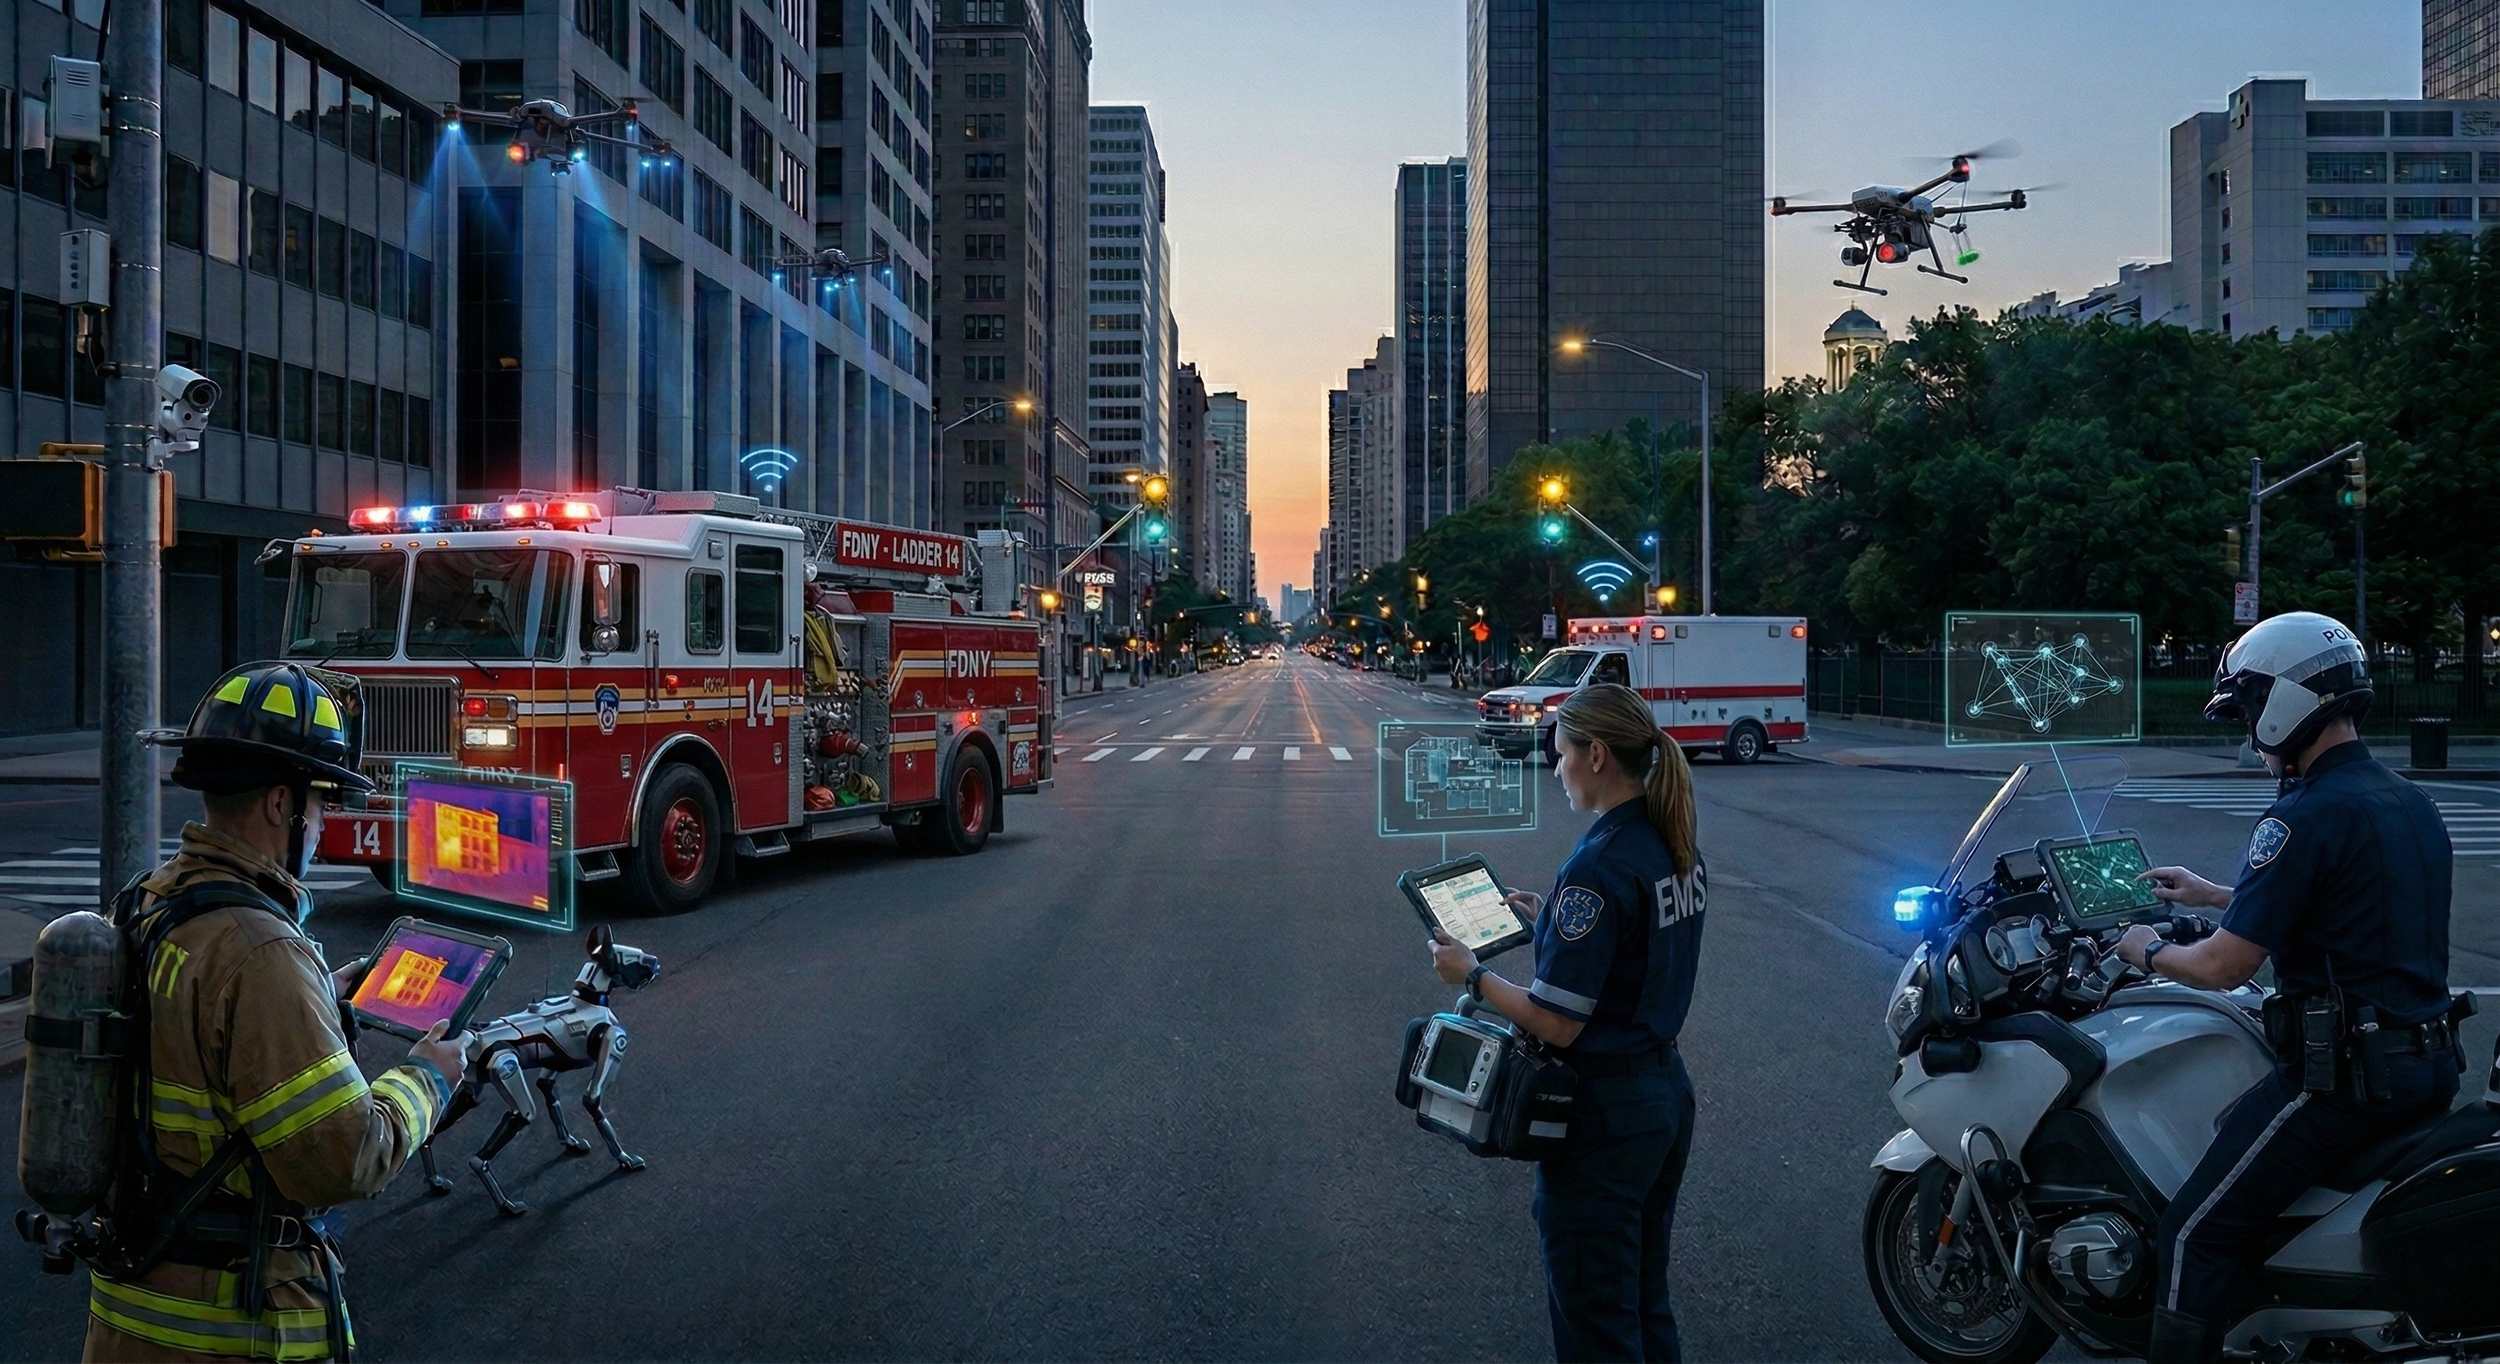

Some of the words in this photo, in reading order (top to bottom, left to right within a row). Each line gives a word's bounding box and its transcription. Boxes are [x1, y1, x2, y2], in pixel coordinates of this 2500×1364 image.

[842, 530, 880, 560] FDNY
[892, 537, 942, 567] LADDER
[945, 543, 959, 569] 14
[947, 649, 991, 678] FDNY
[746, 678, 775, 727] 14
[353, 820, 381, 856] 14
[1654, 864, 1707, 929] EMS
